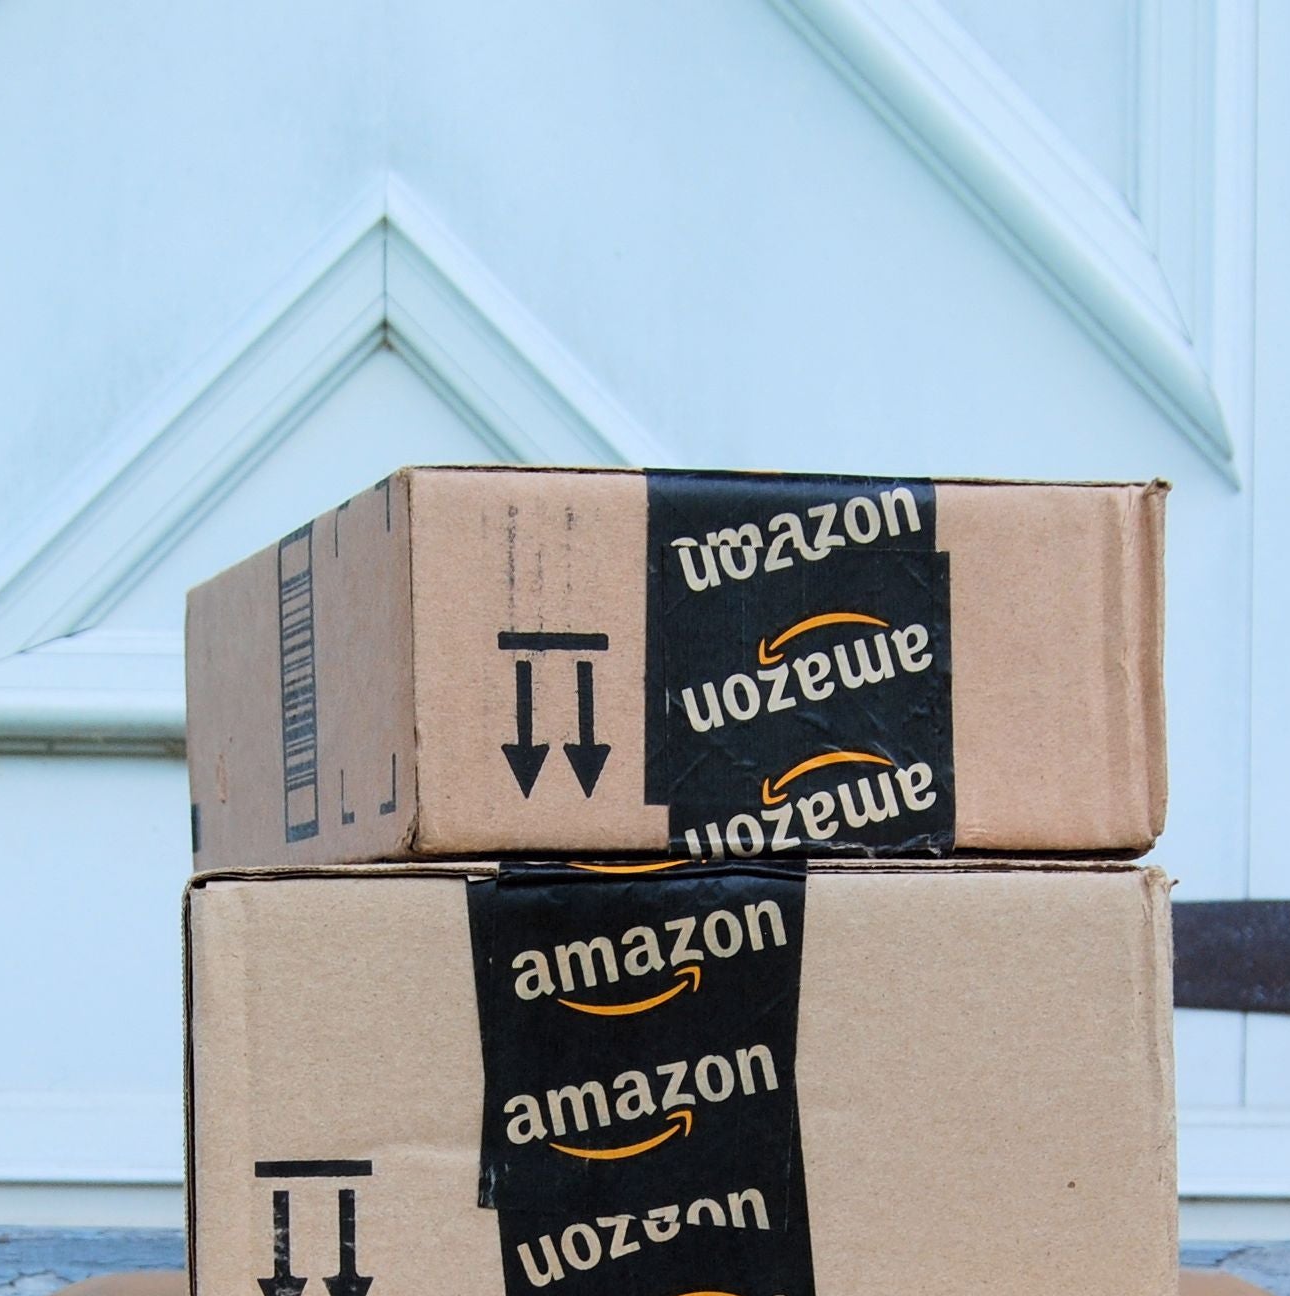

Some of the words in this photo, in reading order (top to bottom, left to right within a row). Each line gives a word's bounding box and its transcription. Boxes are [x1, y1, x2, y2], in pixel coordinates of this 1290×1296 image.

[681, 623, 933, 733] amazon
[684, 762, 936, 861] amazon
[512, 899, 787, 1002] amazon
[503, 1042, 778, 1145] amazon
